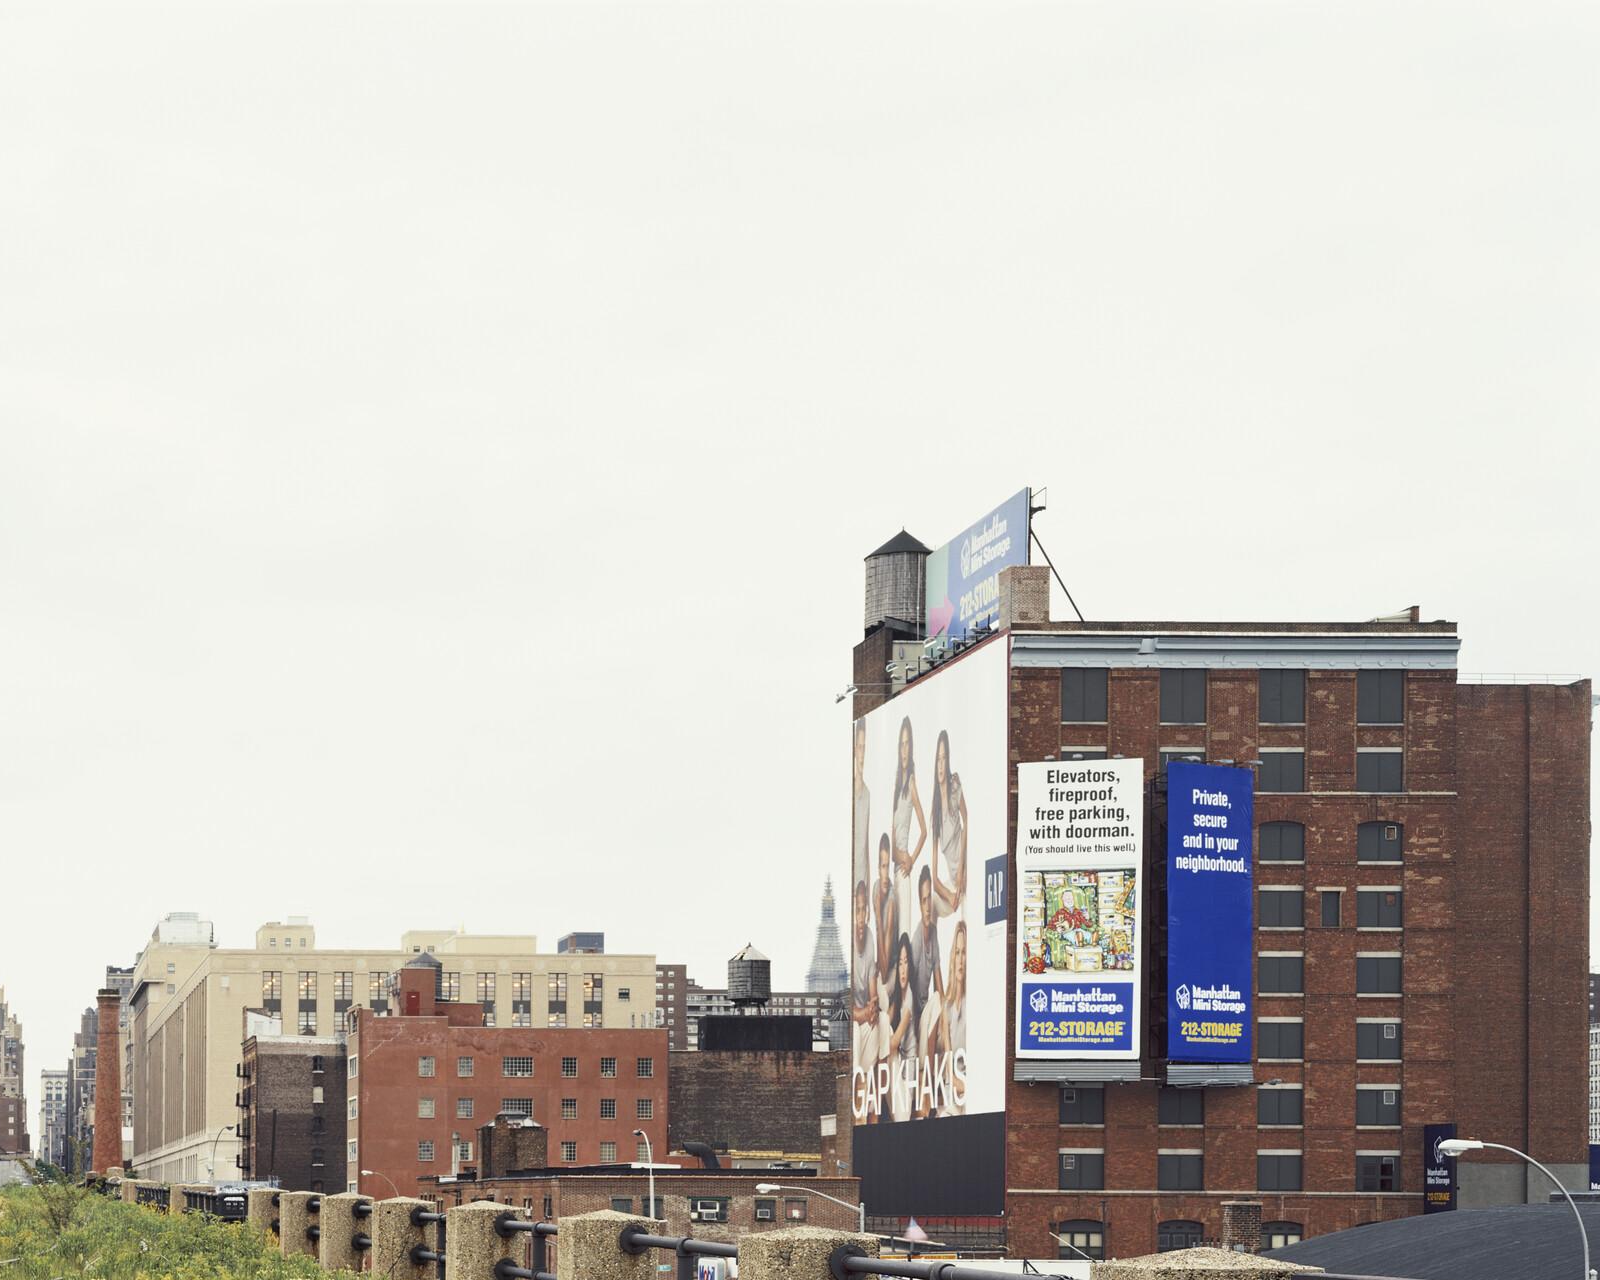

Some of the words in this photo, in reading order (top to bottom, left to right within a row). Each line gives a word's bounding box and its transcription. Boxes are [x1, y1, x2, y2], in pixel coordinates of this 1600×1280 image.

[960, 573, 1000, 622] 212-STORA
[1047, 769, 1120, 784] Elevators,
[1049, 786, 1118, 805] fireproof,
[1192, 788, 1232, 809] Private,
[1035, 807, 1064, 821] free
[1069, 805, 1130, 823] parking,
[1193, 814, 1228, 829] secure
[1029, 825, 1061, 839] with
[1065, 824, 1135, 839] doorman.
[1025, 845, 1044, 856] (You
[1045, 844, 1074, 854] should
[1076, 844, 1092, 853] live
[1094, 843, 1111, 852] this
[1113, 843, 1136, 853] well.)
[1183, 832, 1202, 849] and
[1204, 833, 1215, 849] in
[1216, 836, 1239, 853] your
[1175, 854, 1248, 873] neighborhood.
[987, 870, 1004, 910] GAP
[1051, 987, 1117, 1002] Manhattan
[1192, 984, 1241, 1000] Manhattan
[1051, 1002, 1076, 1013] Mini
[1077, 1002, 1124, 1015] Storage
[1192, 999, 1211, 1011] Mini
[1212, 999, 1246, 1014] Storage
[1029, 1021, 1123, 1036] 212-STORAGE
[1181, 1021, 1242, 1037] 212-STORAGE
[852, 1062, 890, 1119] GAP
[891, 1047, 966, 1115] KHAKIS
